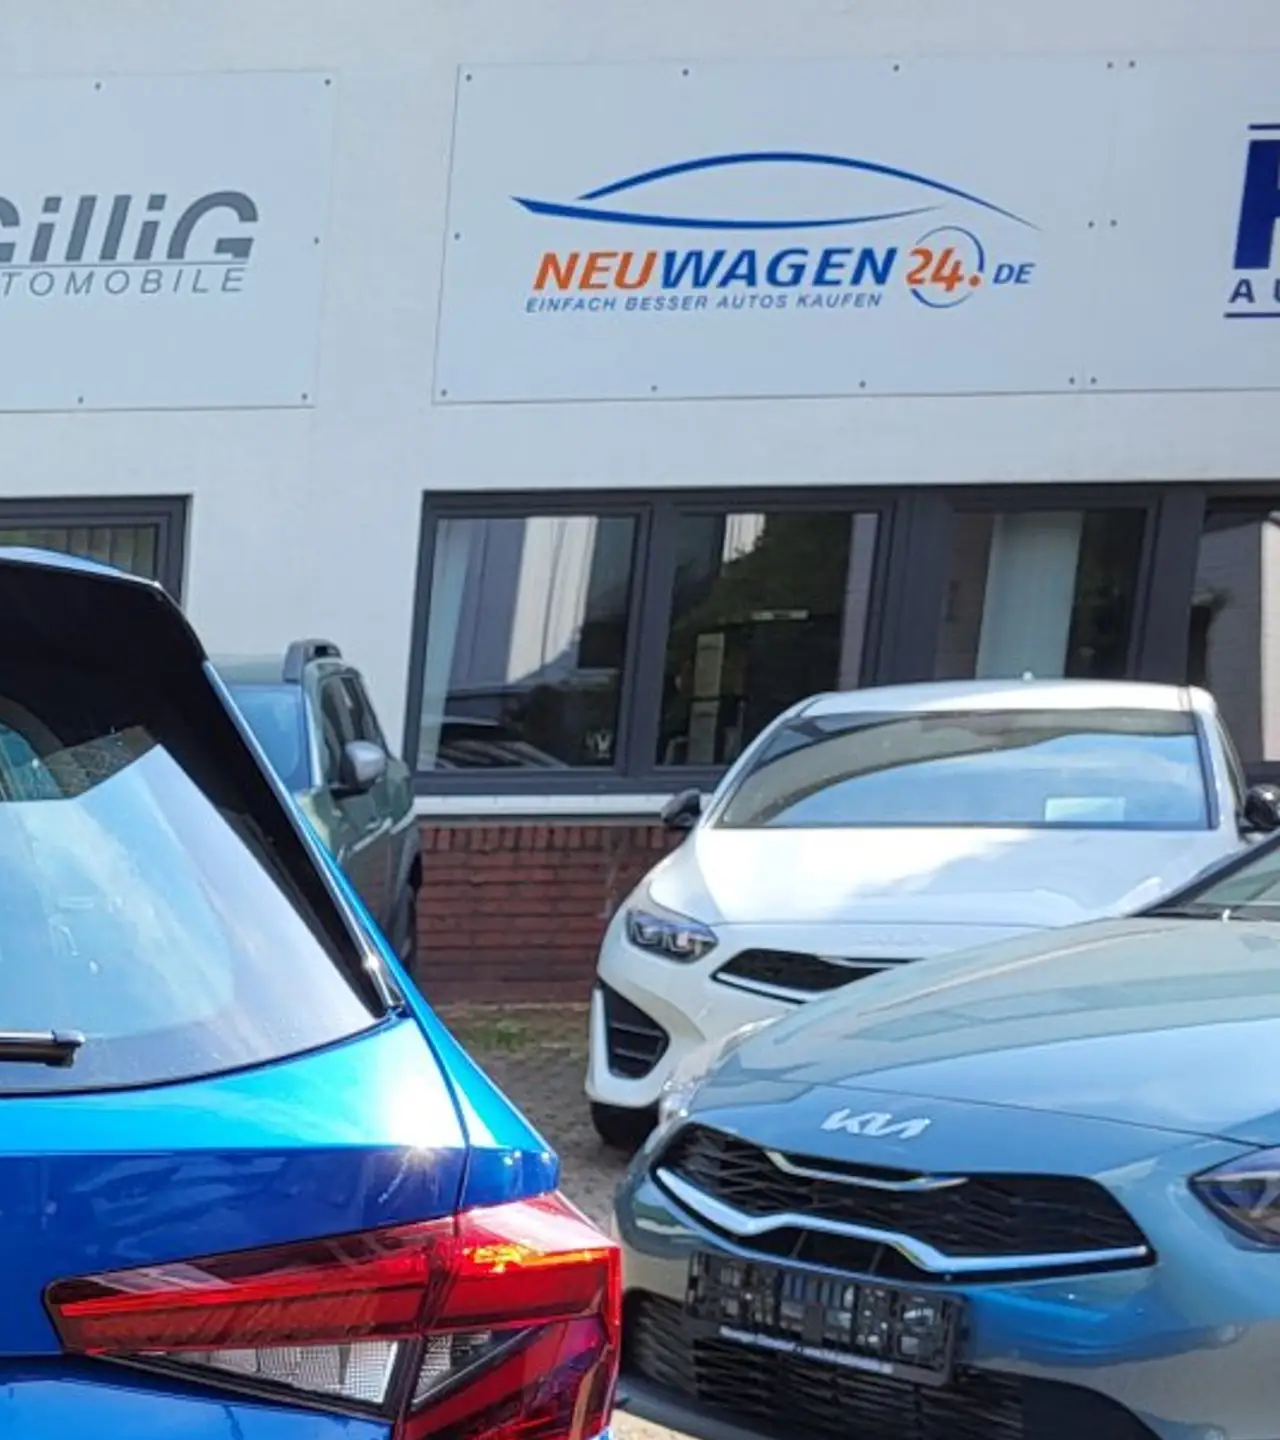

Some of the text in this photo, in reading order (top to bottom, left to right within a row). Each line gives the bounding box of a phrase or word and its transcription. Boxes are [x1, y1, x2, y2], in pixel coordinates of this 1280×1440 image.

[526, 292, 883, 313] EINFACH BESSER AUTOS KAUFEN
